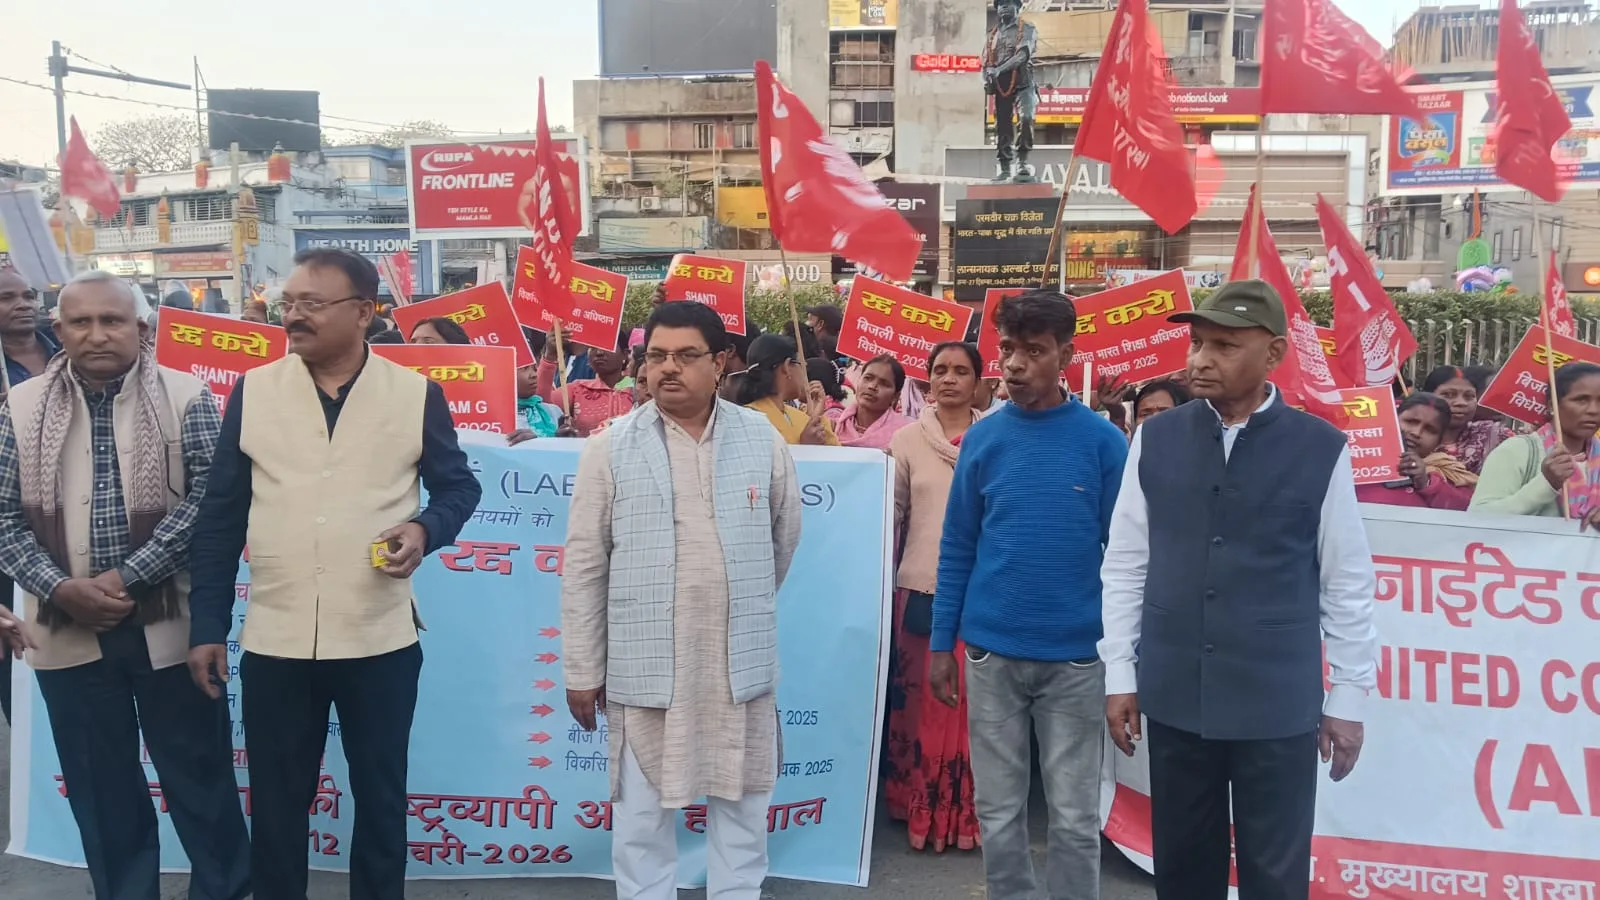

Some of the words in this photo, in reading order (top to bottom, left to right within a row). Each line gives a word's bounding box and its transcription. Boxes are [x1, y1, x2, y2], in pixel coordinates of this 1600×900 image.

[917, 54, 949, 68] Gold
[433, 152, 474, 163] RUPA
[421, 173, 515, 190] FRONTLINE
[308, 239, 369, 251] HEALTH
[373, 239, 419, 251] HOME
[611, 264, 659, 272] MEDICAL
[697, 265, 734, 285] करो
[685, 291, 717, 305] SHANTI
[1104, 289, 1176, 326] करो
[720, 312, 739, 326] 025
[861, 291, 897, 316] रद्द
[901, 304, 956, 333] करो
[169, 322, 206, 347] रद्द
[211, 331, 272, 358] करो
[856, 317, 895, 342] बिजली
[898, 333, 936, 353] संशोध
[1097, 343, 1120, 360] भारत
[1122, 337, 1148, 354] शिक्षा
[1150, 324, 1191, 346] अधिष्ठान
[428, 361, 486, 382] करो
[1134, 354, 1159, 370] 2025
[475, 400, 488, 414] G
[1353, 465, 1392, 479] 2025
[531, 507, 555, 528] को
[439, 541, 520, 575] रद्द
[786, 710, 819, 726] 2025
[565, 751, 609, 772] विकसि
[804, 758, 834, 777] 2025
[407, 784, 557, 833] ष्ट्रव्यापी
[308, 829, 340, 855] 12
[1338, 857, 1488, 898] मुख्यालय
[1503, 875, 1597, 900] शाखा
